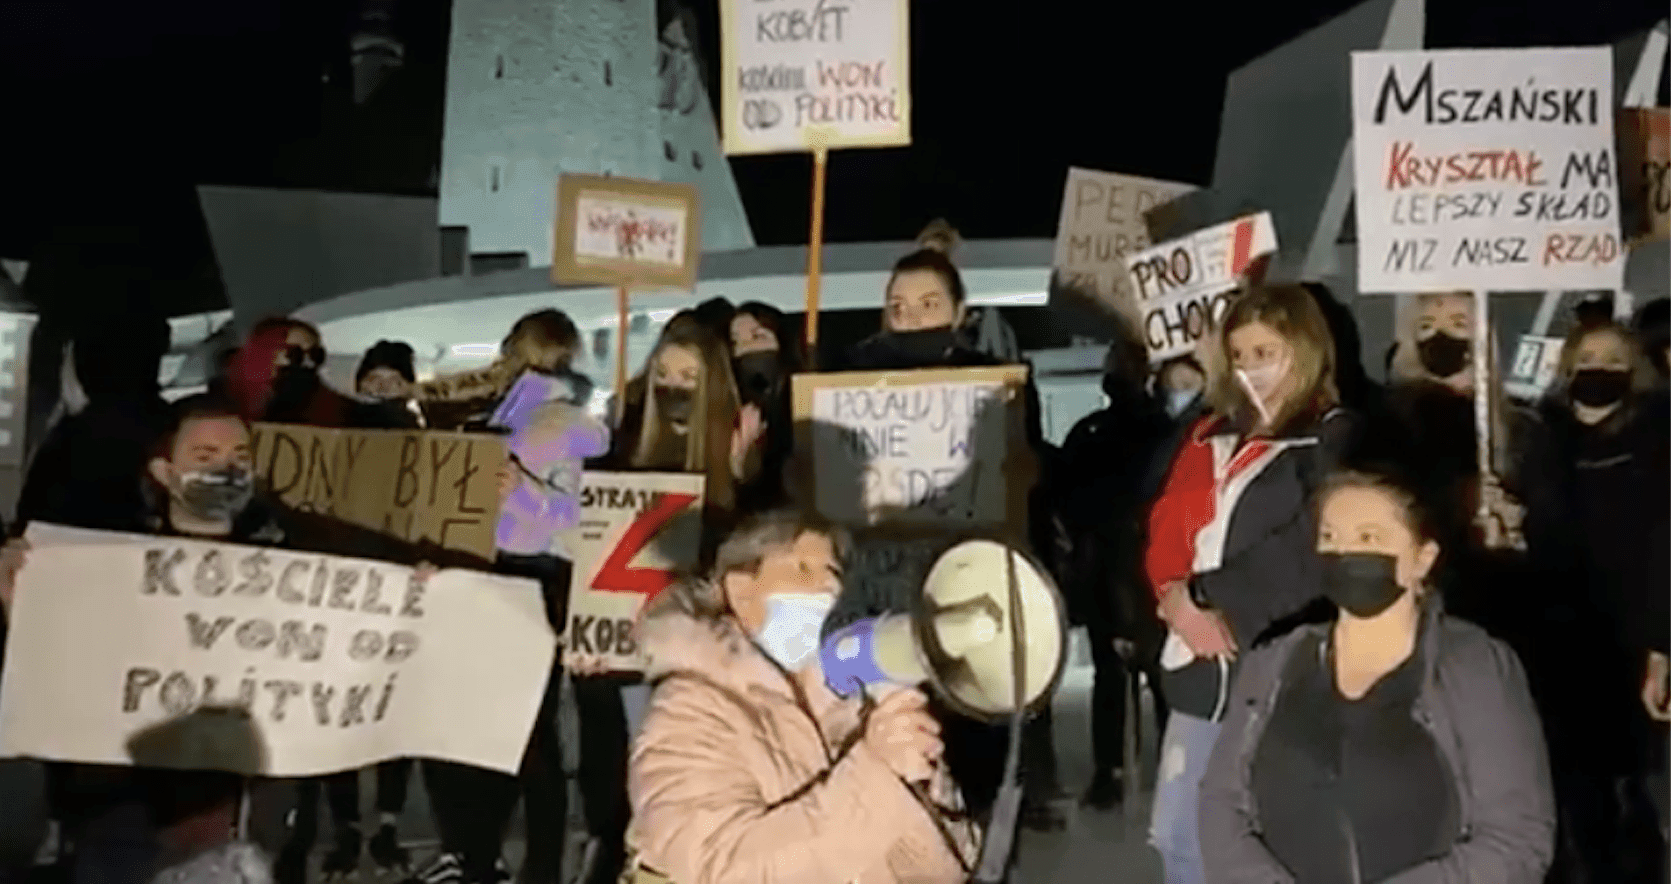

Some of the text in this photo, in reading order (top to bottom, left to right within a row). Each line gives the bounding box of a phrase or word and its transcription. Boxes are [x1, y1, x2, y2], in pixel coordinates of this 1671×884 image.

[816, 60, 884, 89] WON
[1374, 59, 1597, 125] MSZAŃSKI
[742, 99, 782, 131] OD
[1386, 141, 1547, 190] KRYSZTAŁ
[1560, 147, 1612, 190] MA
[1391, 191, 1612, 225] LEPSZY SKŁAD
[1130, 248, 1192, 300] PRO
[1452, 237, 1528, 267] NASZ
[394, 435, 487, 514] BYŁ
[185, 612, 419, 663] WON OD
[571, 615, 637, 656] KOB
